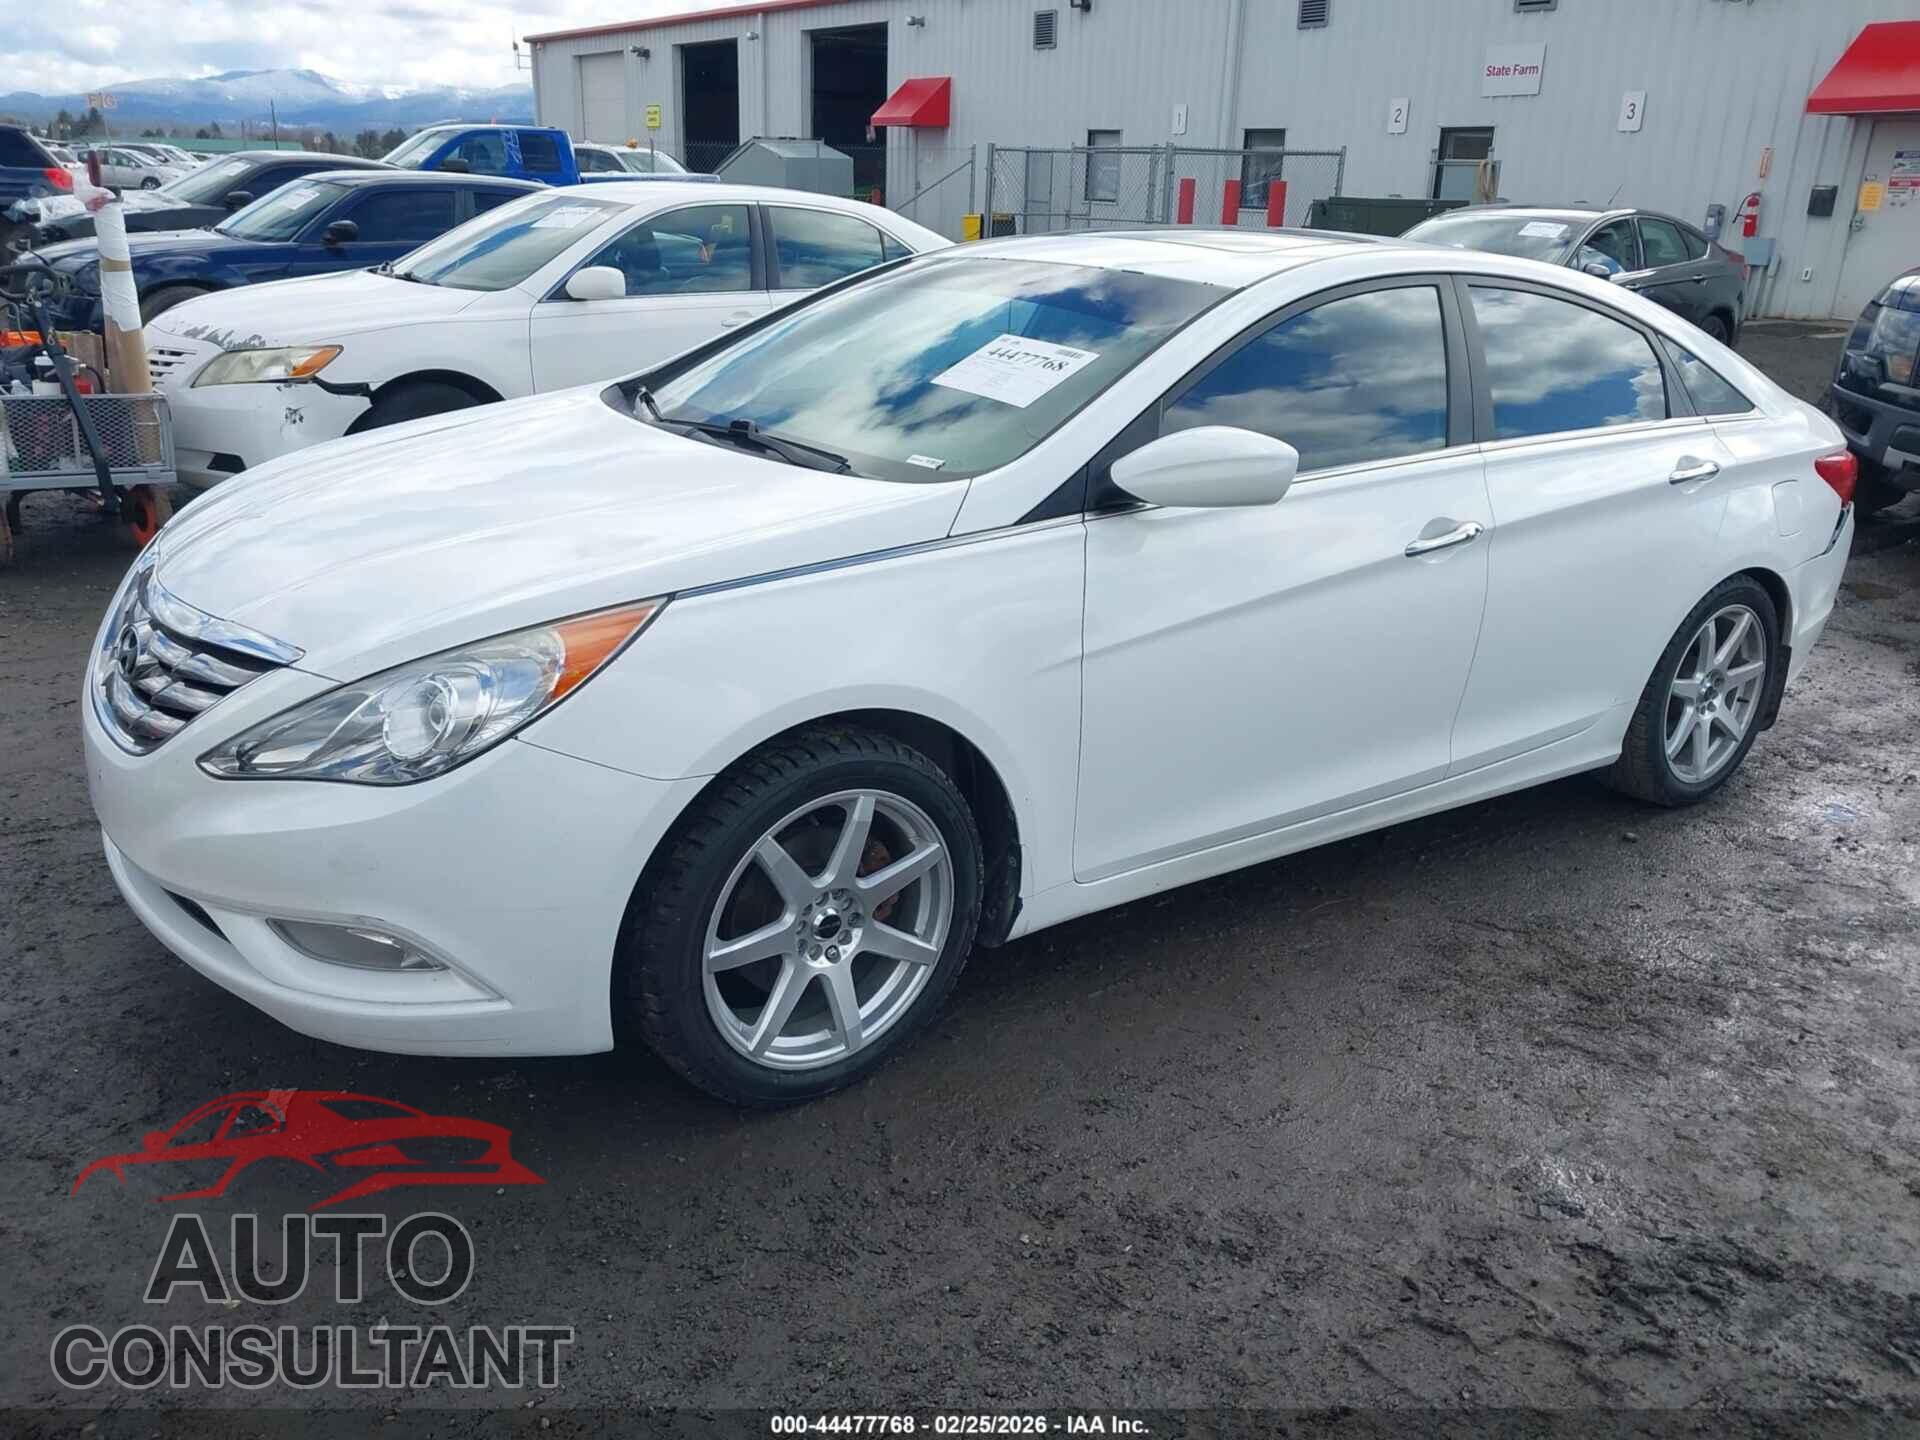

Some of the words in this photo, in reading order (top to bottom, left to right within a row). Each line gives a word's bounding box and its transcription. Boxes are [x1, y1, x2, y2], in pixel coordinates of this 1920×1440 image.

[1486, 64, 1511, 77] State
[1512, 63, 1539, 76] Farm
[1393, 107, 1402, 123] 2
[1626, 103, 1636, 120] 3
[987, 346, 1069, 371] 44477768
